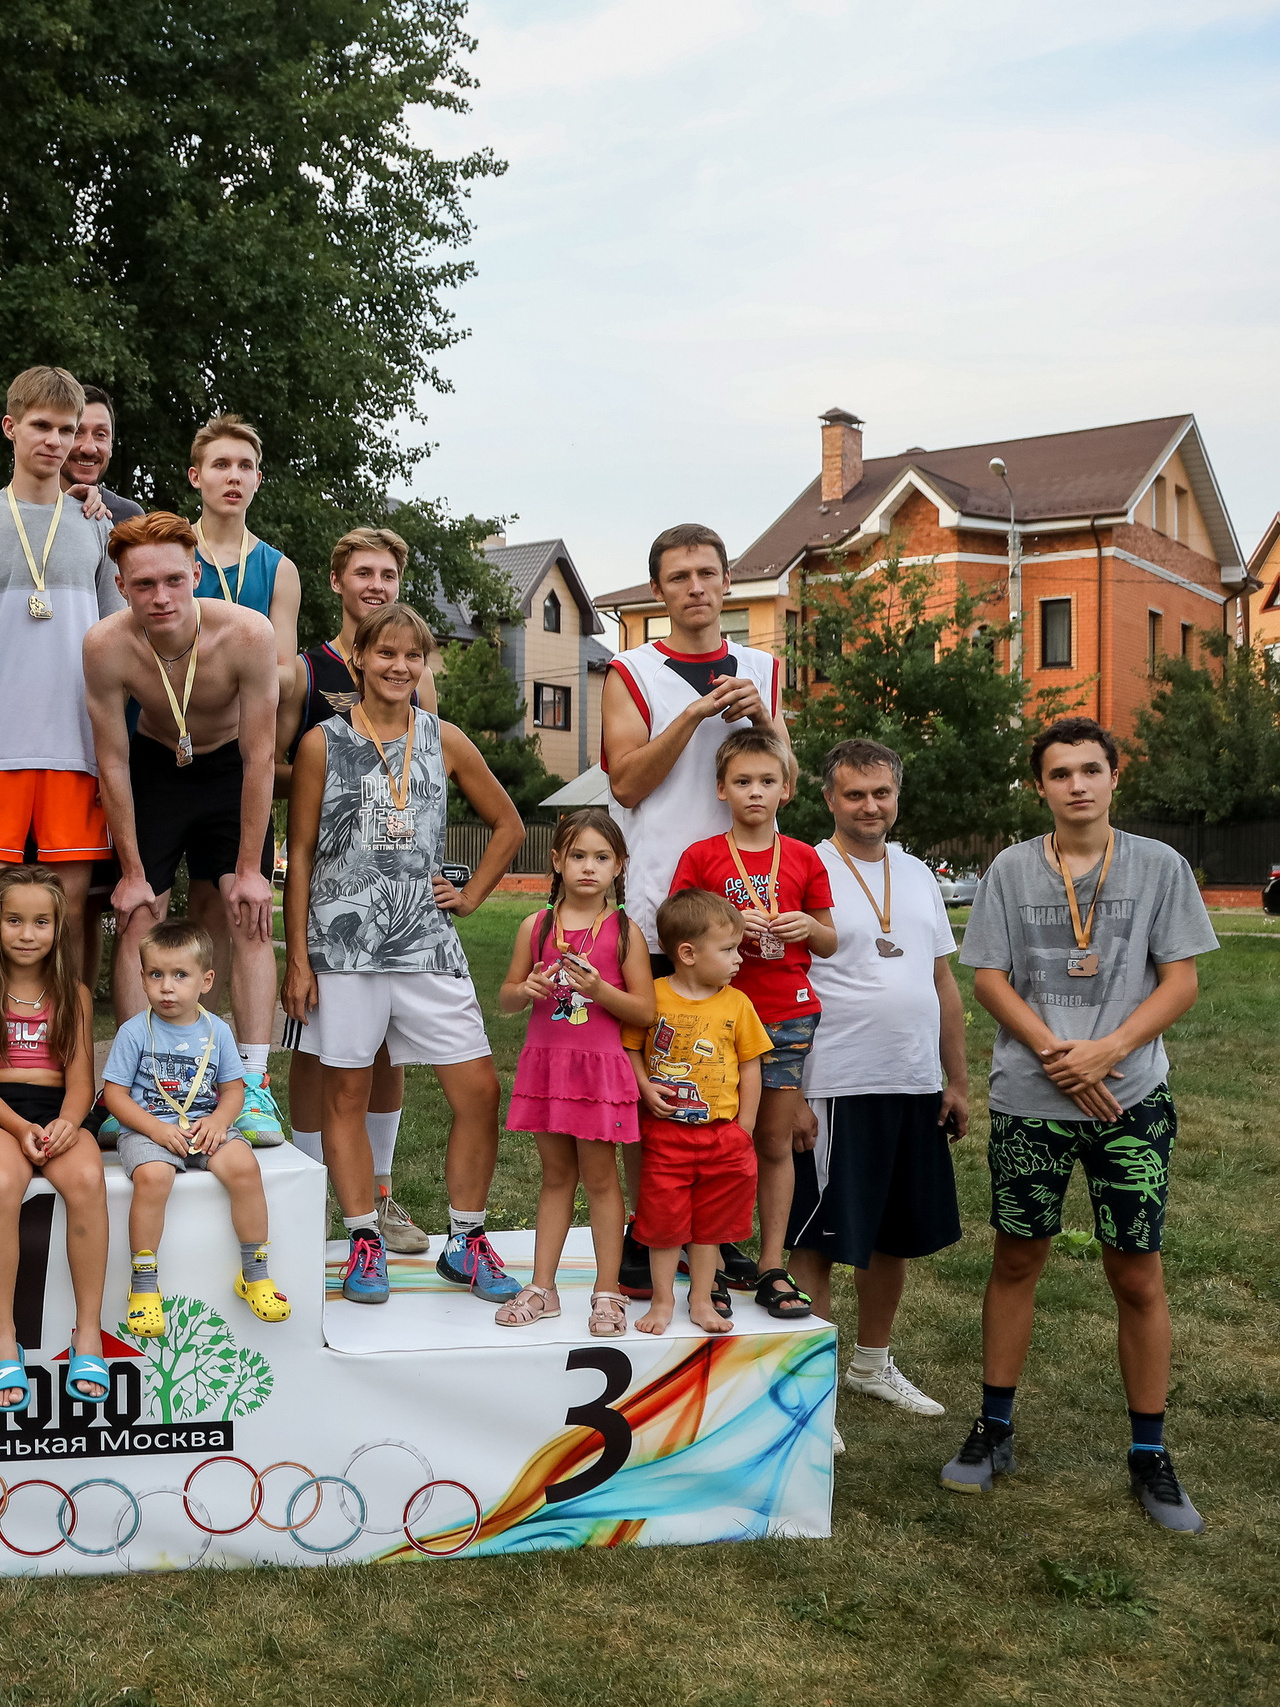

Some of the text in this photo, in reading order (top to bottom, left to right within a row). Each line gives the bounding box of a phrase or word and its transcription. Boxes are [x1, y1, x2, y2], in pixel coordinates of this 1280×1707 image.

[6, 1022, 48, 1042] FILA
[1135, 1221, 1151, 1250] Never
[13, 1193, 56, 1349] 1
[100, 1429, 225, 1451] Москва
[545, 1346, 633, 1505] 3
